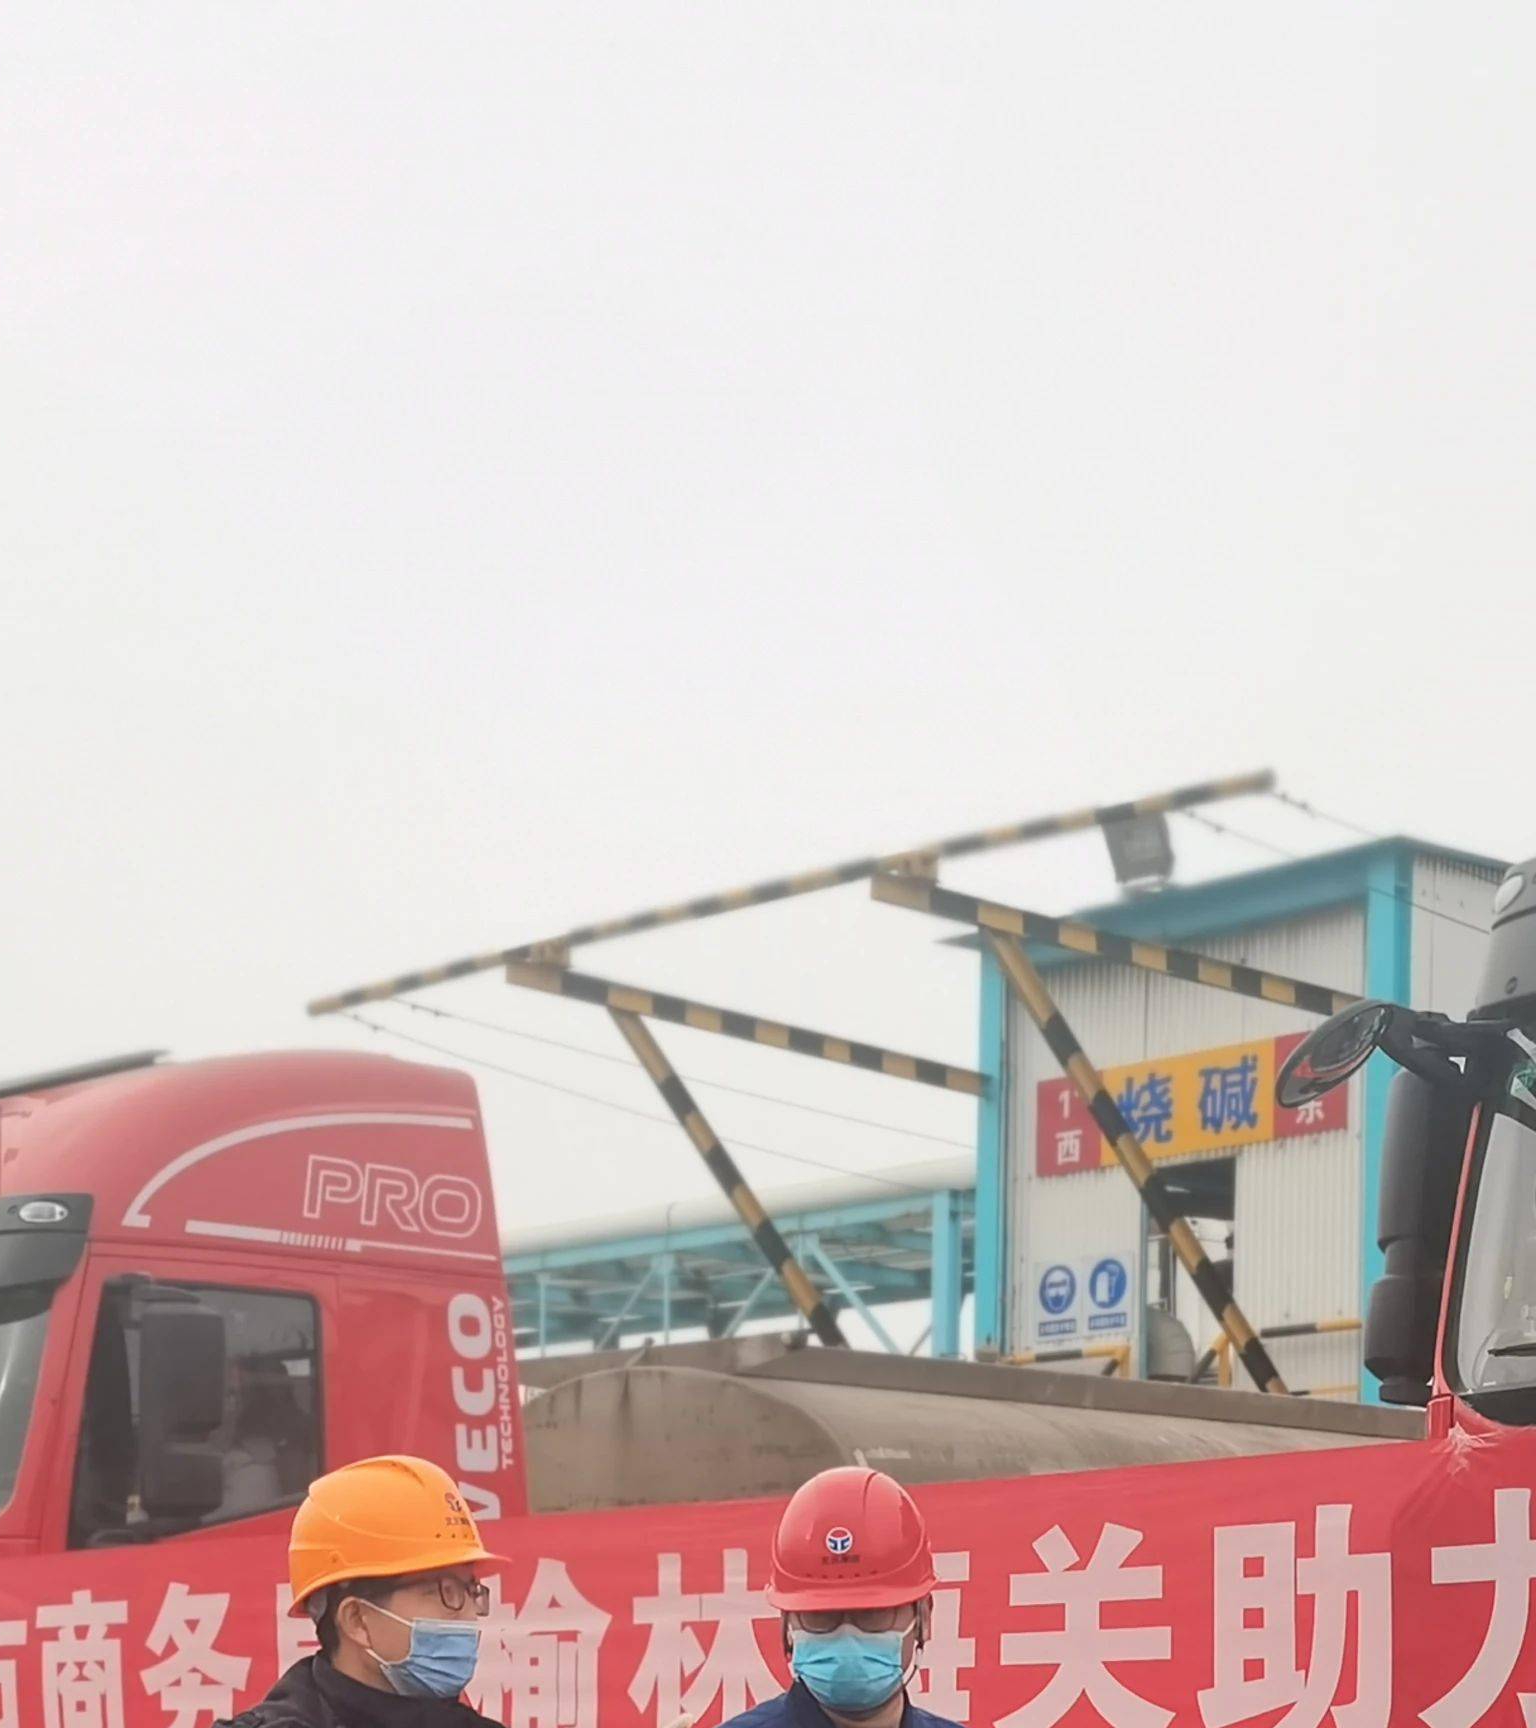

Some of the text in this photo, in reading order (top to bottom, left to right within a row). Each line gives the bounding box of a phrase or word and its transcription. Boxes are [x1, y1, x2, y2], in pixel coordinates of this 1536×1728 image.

[1116, 1054, 1258, 1143] 烧碱
[303, 1154, 482, 1238] PRO
[492, 1295, 515, 1470] TECHNOLOGY
